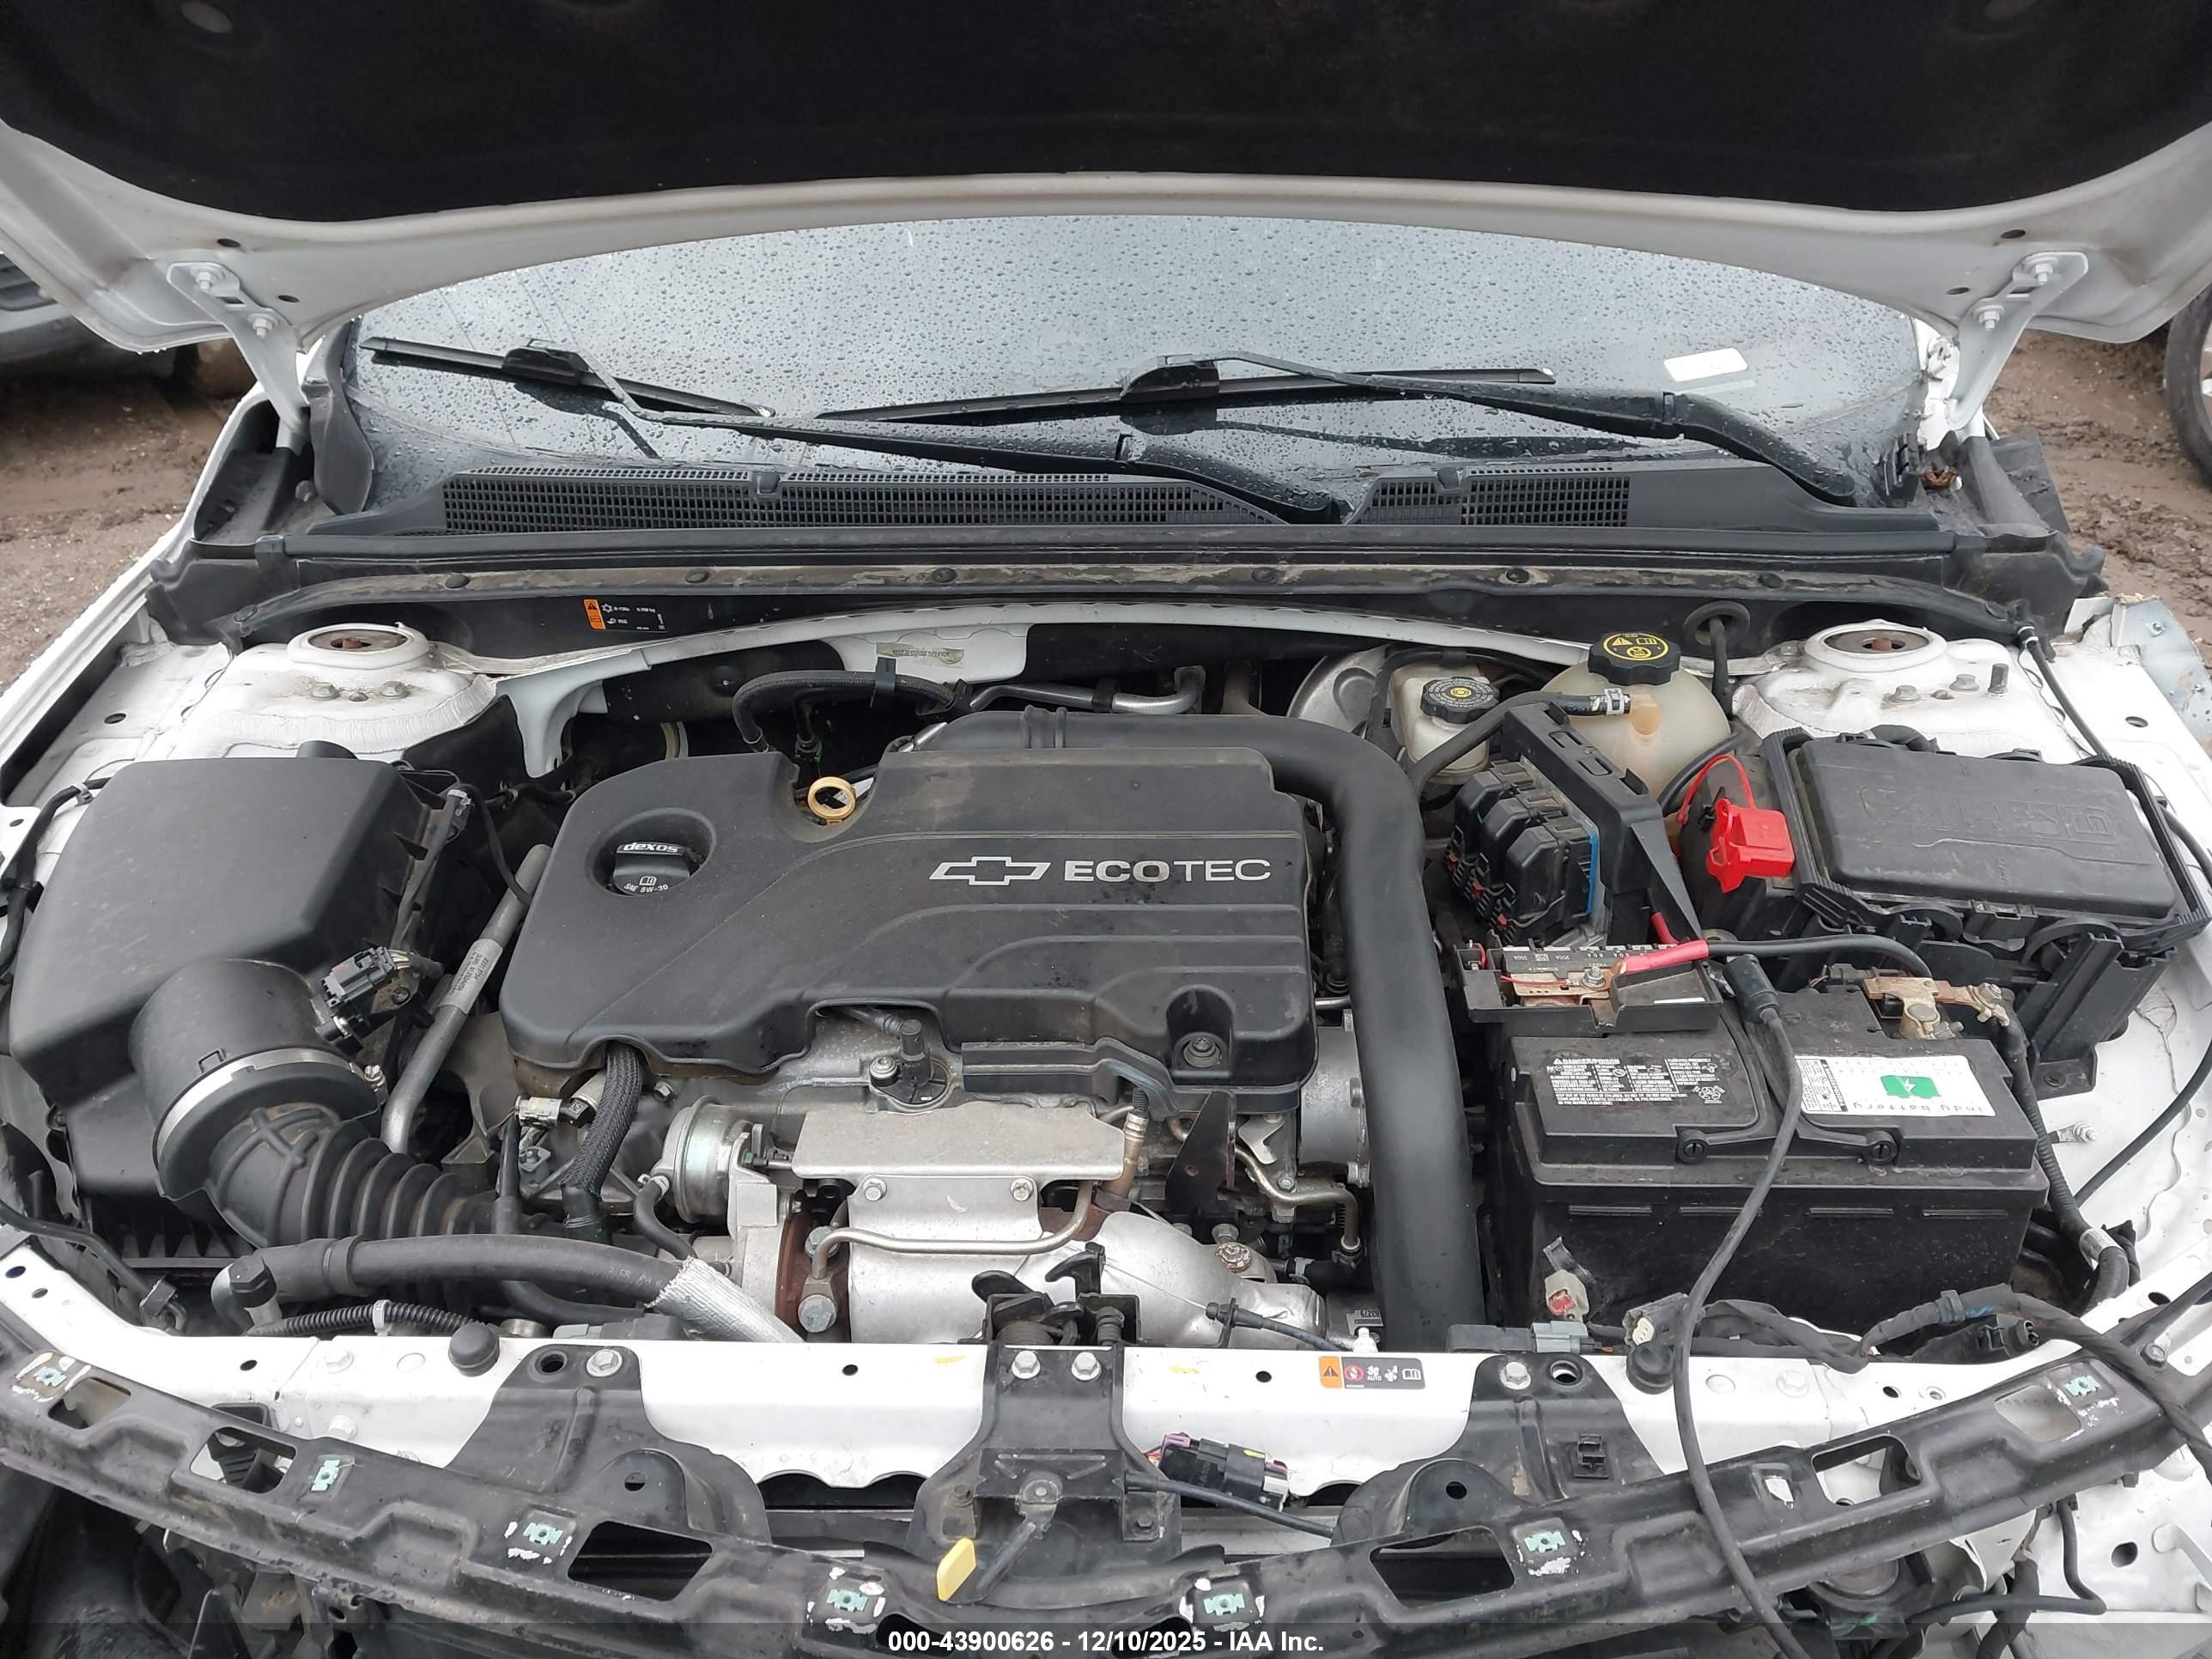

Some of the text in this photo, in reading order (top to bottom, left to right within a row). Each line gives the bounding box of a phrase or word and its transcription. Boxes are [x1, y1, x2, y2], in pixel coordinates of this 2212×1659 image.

[623, 842, 680, 853] dexos
[1064, 859, 1271, 882] ECOTEC
[623, 883, 669, 893] SAE 5W-30
